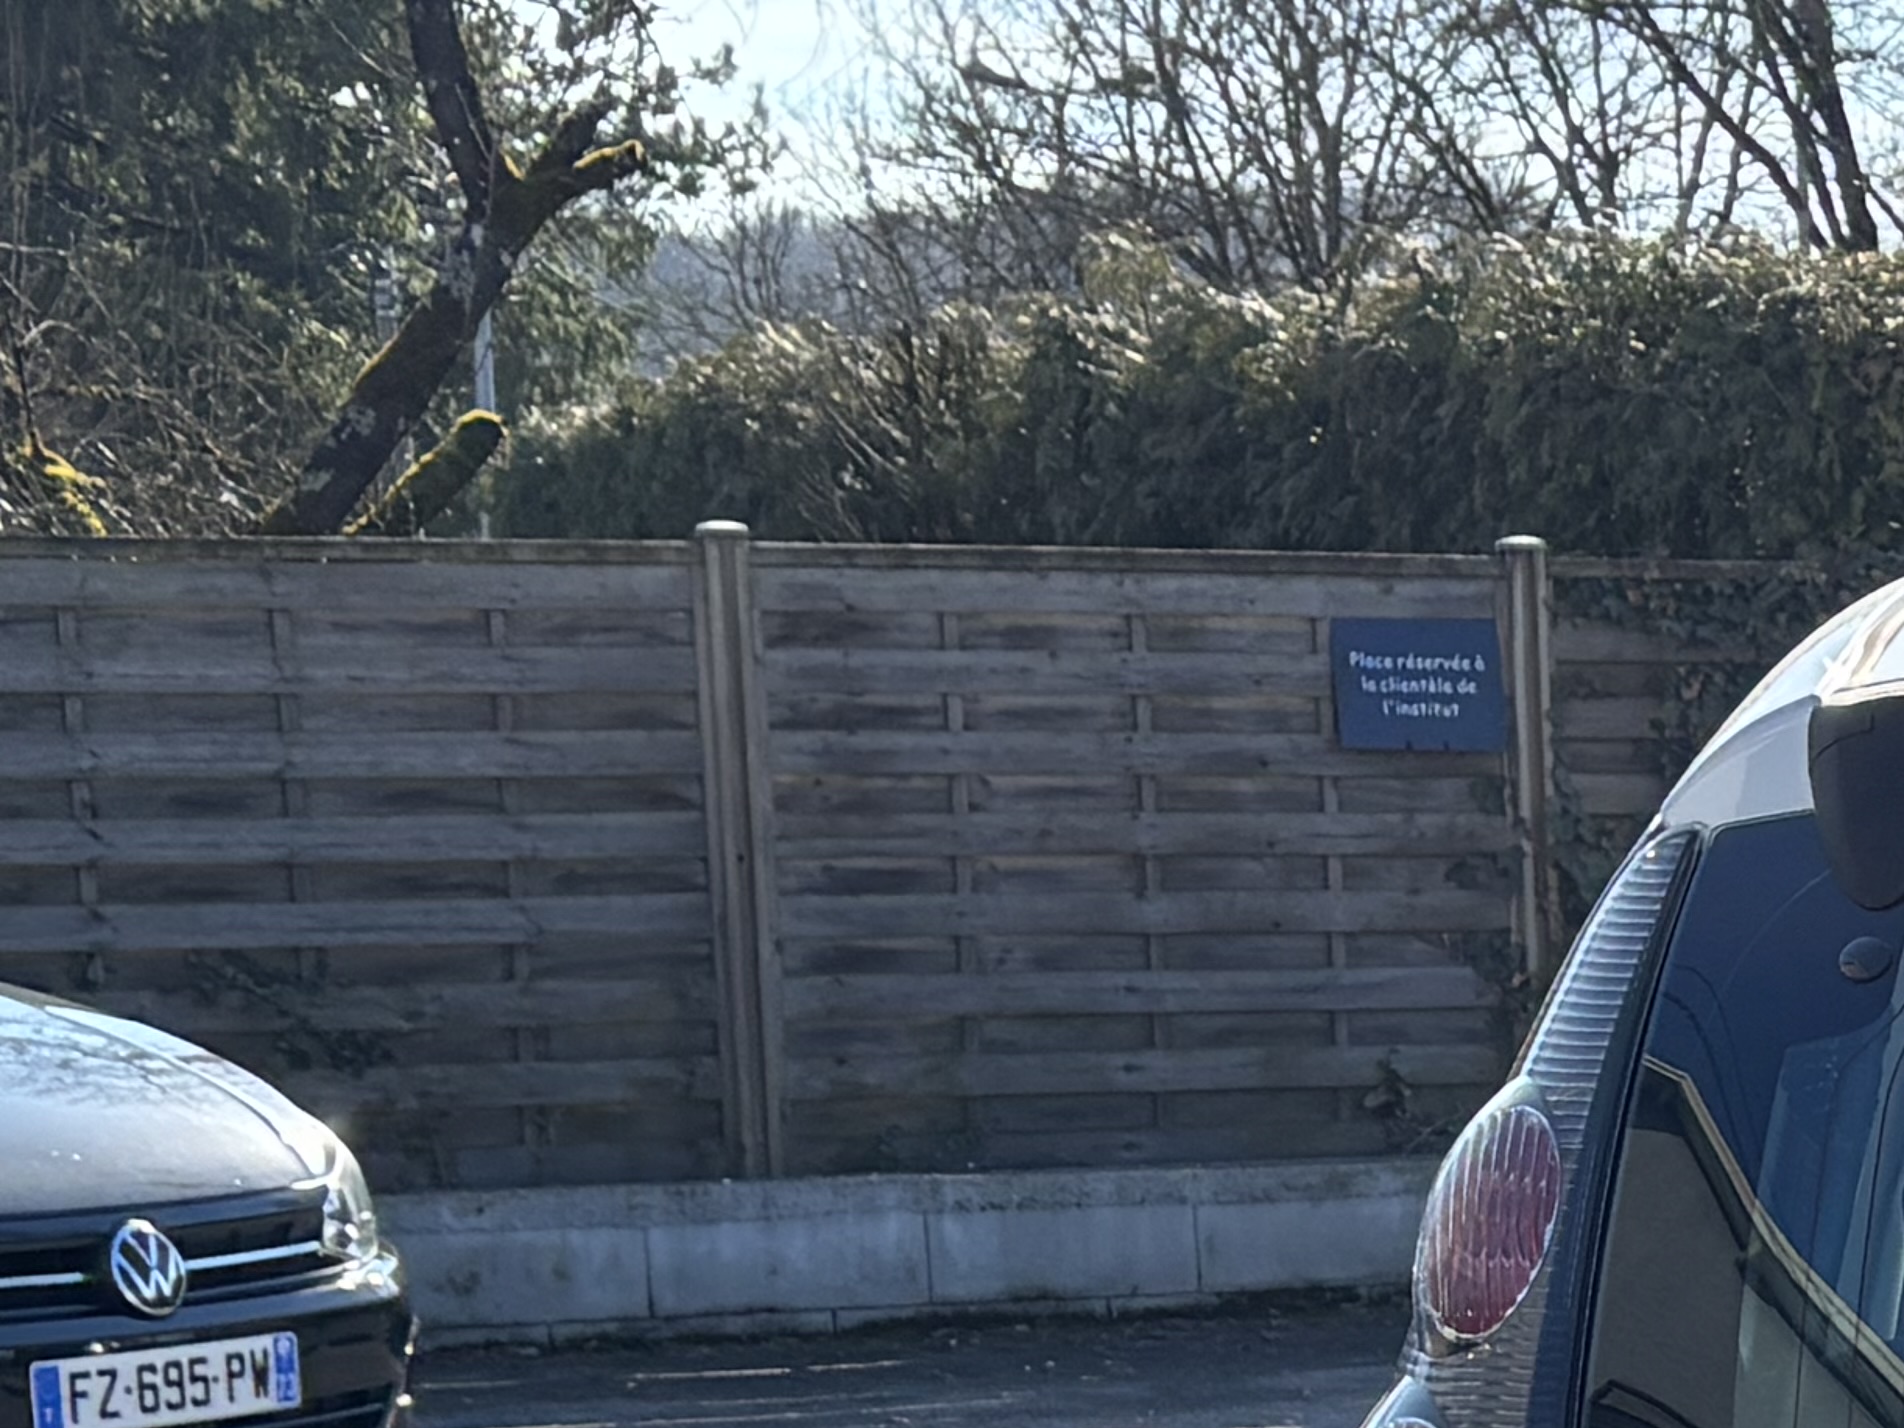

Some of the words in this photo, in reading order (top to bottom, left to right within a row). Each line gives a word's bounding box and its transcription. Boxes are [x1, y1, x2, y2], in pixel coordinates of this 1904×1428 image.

[1349, 651, 1392, 669] Place
[1397, 653, 1470, 671] réservée
[1474, 655, 1485, 671] à
[1361, 676, 1376, 691] la
[1380, 677, 1452, 694] clientèle
[1457, 678, 1477, 694] de
[1383, 700, 1459, 717] l'institut
